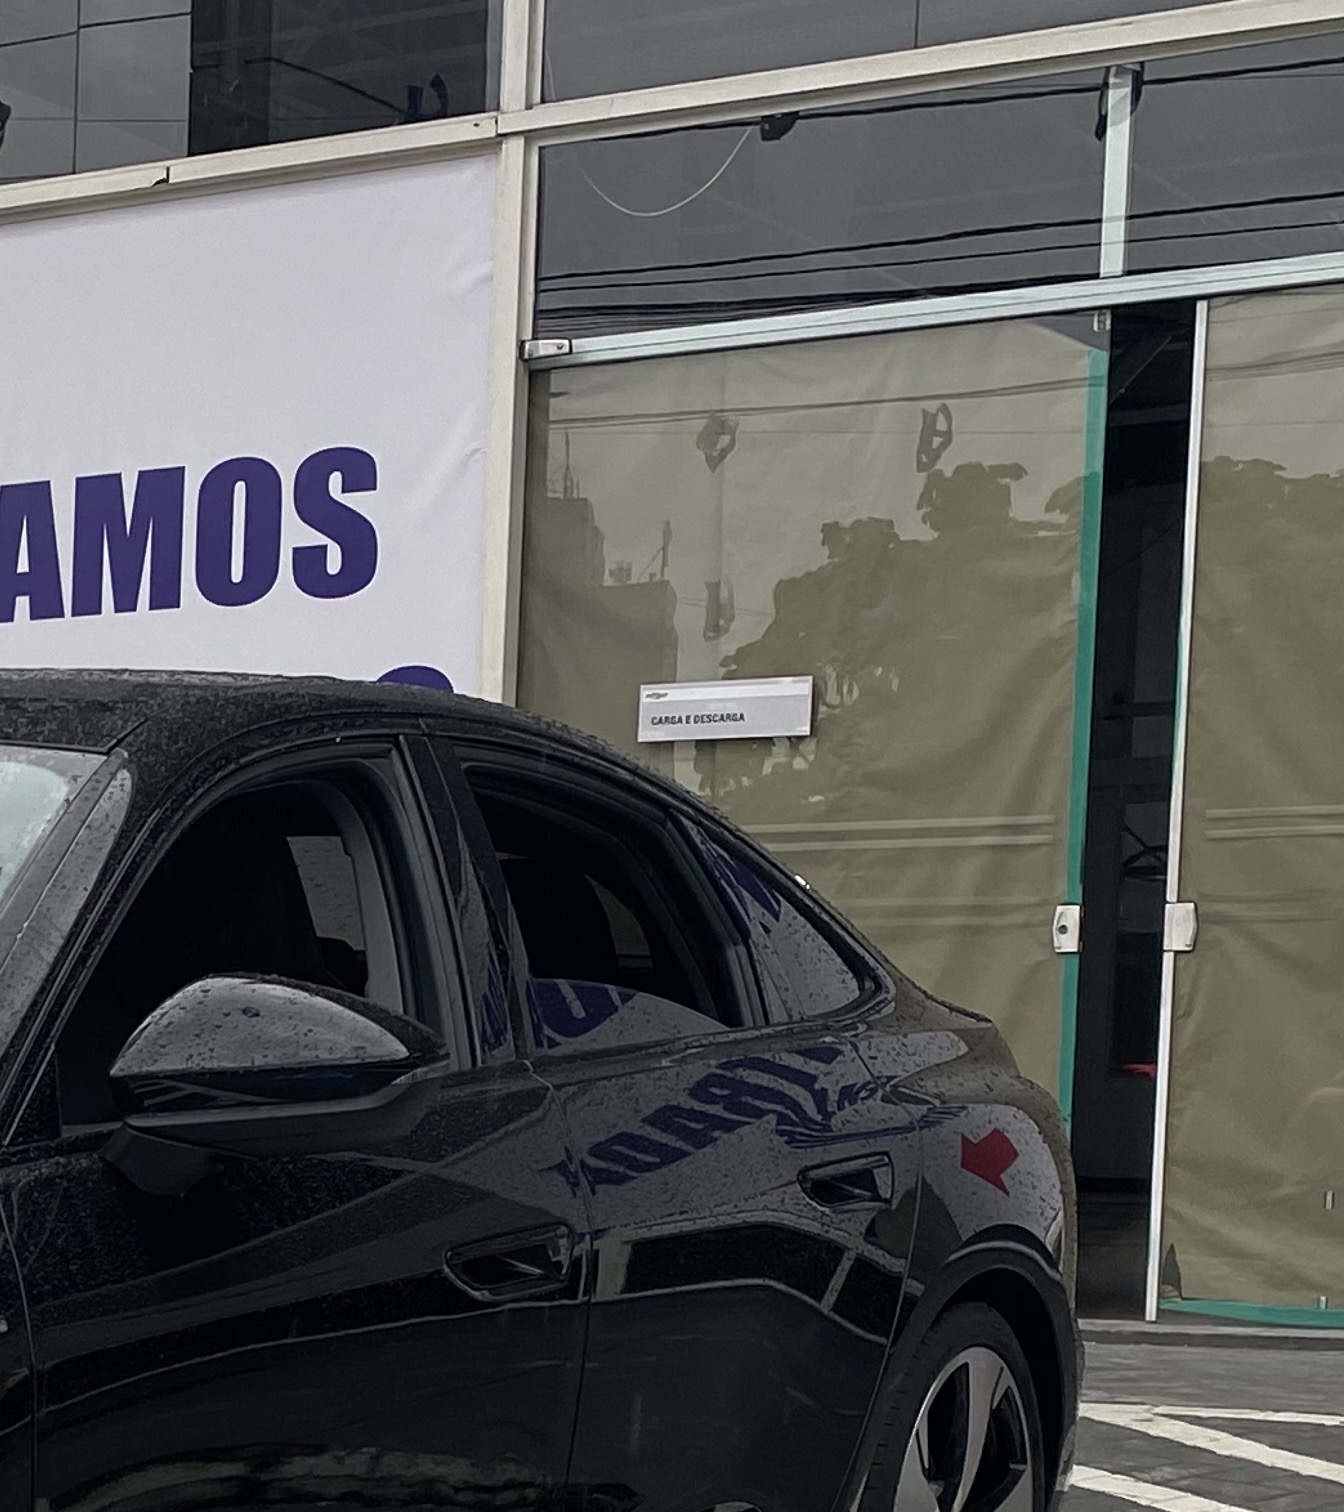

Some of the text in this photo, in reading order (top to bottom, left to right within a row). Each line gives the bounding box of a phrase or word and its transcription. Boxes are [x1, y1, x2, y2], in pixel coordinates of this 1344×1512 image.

[651, 713, 745, 726] CARGA E DESCARGA
